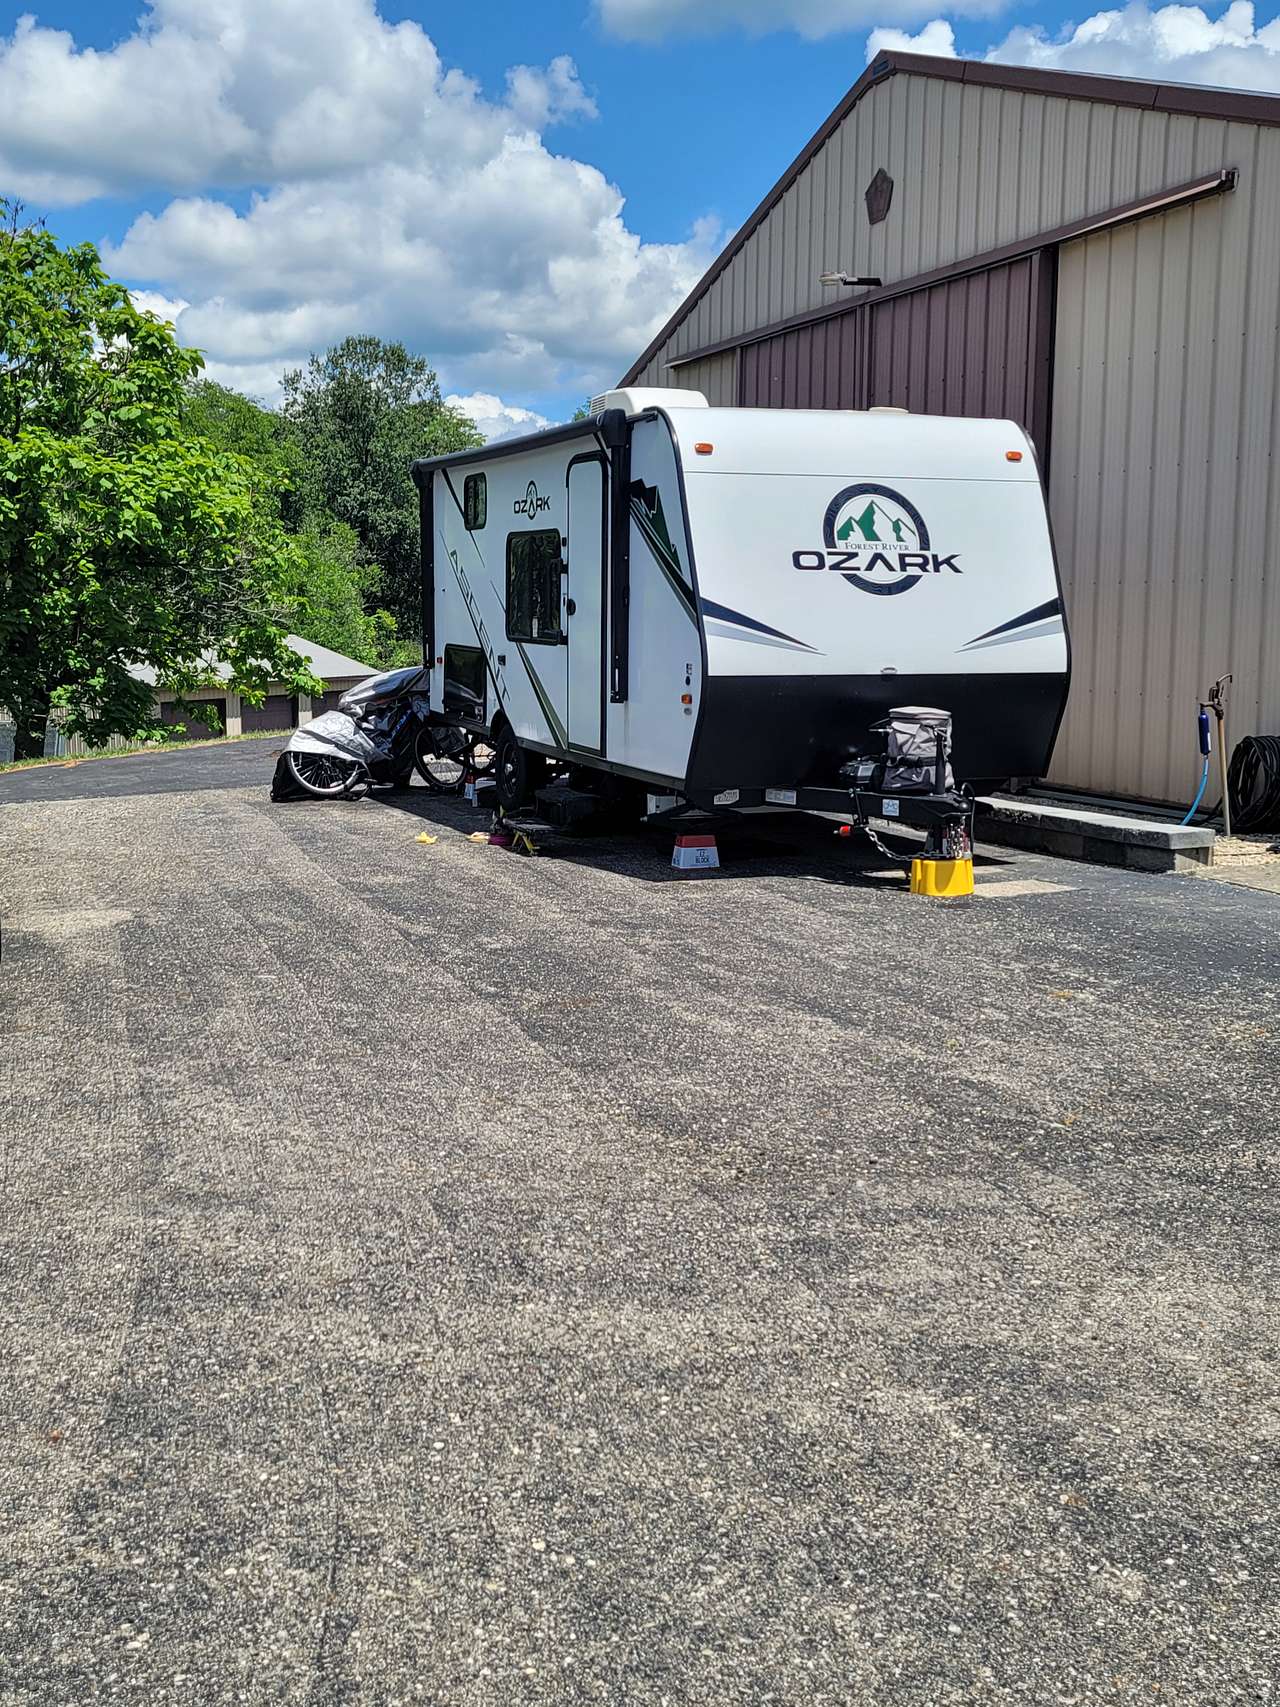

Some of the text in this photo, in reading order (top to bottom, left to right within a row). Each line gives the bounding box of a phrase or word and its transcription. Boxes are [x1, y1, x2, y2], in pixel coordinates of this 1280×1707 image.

[513, 495, 551, 514] OZARK
[845, 542, 911, 551] FOREST RIVER
[792, 550, 963, 574] OZARK
